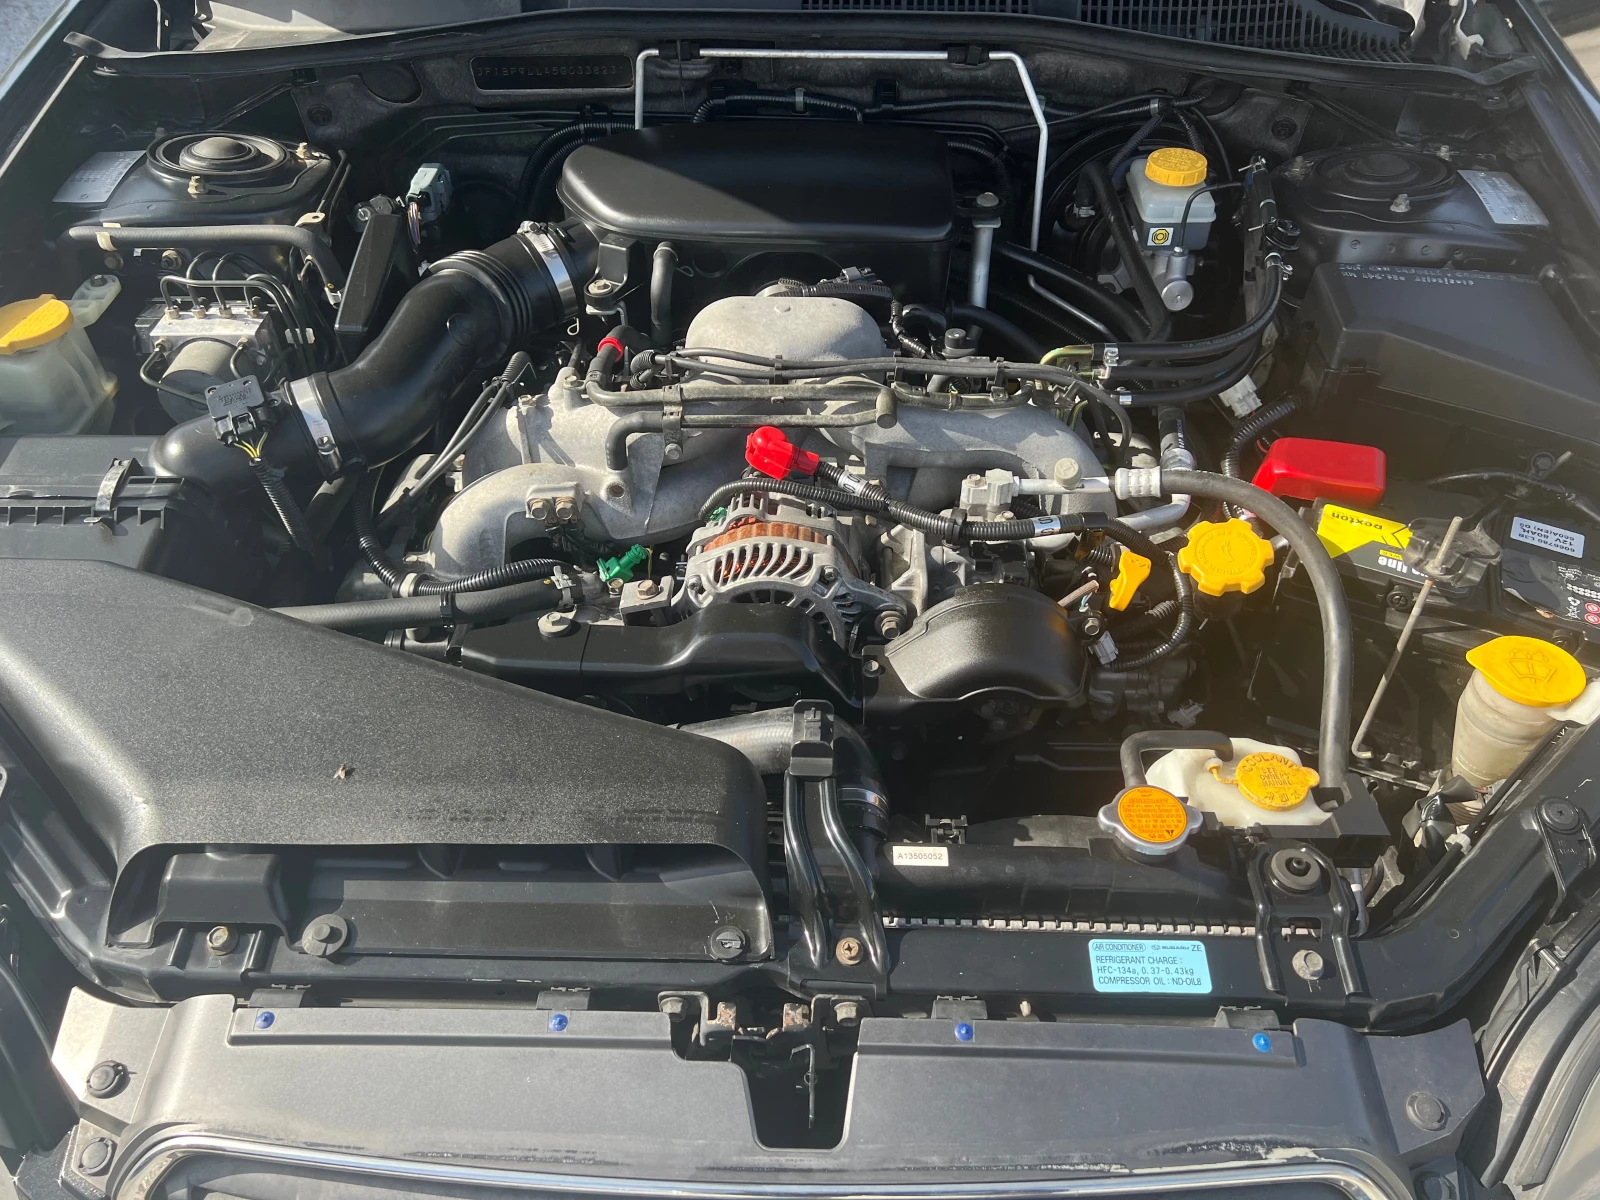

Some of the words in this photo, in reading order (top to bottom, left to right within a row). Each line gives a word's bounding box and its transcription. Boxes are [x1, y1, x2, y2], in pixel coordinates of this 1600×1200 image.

[1332, 512, 1383, 530] Rexton
[1554, 537, 1574, 546] 12V
[1242, 754, 1297, 772] COOLANT
[897, 852, 943, 860] A13505052
[1094, 943, 1104, 951] AIR
[1105, 943, 1144, 951] CONDITIONER
[1191, 944, 1203, 952] ZE
[1095, 955, 1146, 964] REFRIGERANT
[1097, 966, 1140, 976] HFC-134a,
[1098, 976, 1151, 985] COMPRESSOR
